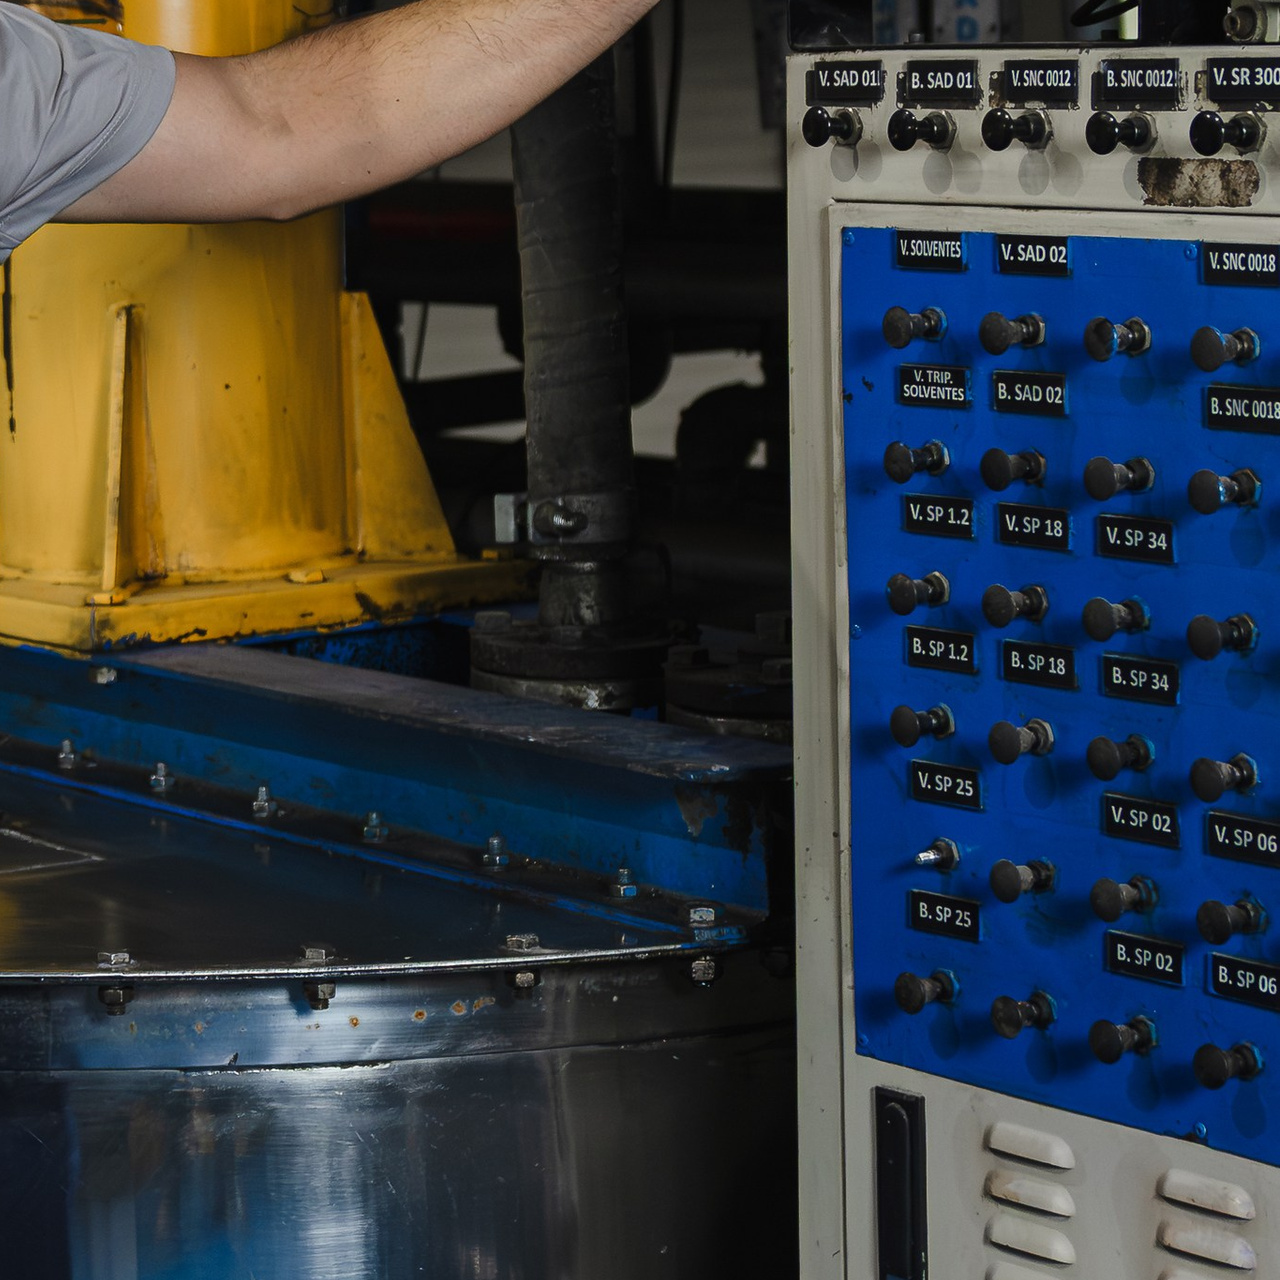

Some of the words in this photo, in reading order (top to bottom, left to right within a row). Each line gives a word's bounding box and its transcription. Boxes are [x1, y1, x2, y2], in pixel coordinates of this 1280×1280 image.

[819, 69, 830, 87] V.
[833, 69, 858, 87] SAD
[911, 72, 924, 88] B.
[927, 71, 954, 89] SAD
[956, 72, 973, 88] 01
[1011, 69, 1021, 87] V.
[1023, 69, 1044, 87] SNC
[1045, 69, 1071, 87] 0012
[1106, 69, 1119, 88] B.
[1120, 69, 1144, 88] SNC
[1213, 67, 1227, 85] V.
[1231, 67, 1250, 86] SR
[900, 239, 909, 256] V.
[910, 239, 961, 258] SOLVENTES
[1001, 243, 1014, 261] V.
[1017, 244, 1046, 263] SAD
[1049, 245, 1067, 264] 02
[1209, 251, 1221, 270] V.
[1222, 252, 1246, 271] SNC
[1248, 253, 1276, 273] 0018
[913, 369, 924, 382] V.
[926, 370, 953, 385] TRIP.
[903, 384, 965, 401] SOLVENTES
[998, 382, 1011, 400] B.
[1014, 385, 1043, 401] SAD
[1045, 386, 1063, 404] 02
[1210, 397, 1223, 416] B.
[1225, 398, 1249, 418] SNC
[1251, 400, 1280, 420] 0018
[909, 503, 923, 520] V.
[926, 505, 944, 522] SP
[947, 508, 970, 526] 1.2
[1005, 514, 1019, 532] V.
[1022, 516, 1040, 535] SP
[1044, 519, 1063, 537] 18
[1106, 526, 1120, 545] V.
[1124, 529, 1143, 547] SP
[1147, 532, 1168, 551] 34
[913, 637, 926, 655] B.
[928, 640, 945, 658] SP
[948, 643, 969, 661] 1.2
[1011, 651, 1024, 670] B.
[1028, 654, 1045, 672] SP
[1048, 657, 1066, 675] 18
[1112, 667, 1126, 685] B.
[1130, 669, 1148, 688] SP
[1151, 672, 1169, 692] 34
[918, 771, 931, 790] V.
[935, 775, 953, 792] SP
[956, 778, 974, 797] 25
[1111, 805, 1126, 824] V.
[1129, 809, 1148, 828] SP
[1152, 813, 1171, 833] 02
[1214, 824, 1229, 845] V.
[1233, 829, 1253, 848] SP
[1257, 833, 1278, 853] 06
[919, 902, 932, 919] B.
[935, 905, 952, 923] SP
[955, 909, 971, 928] 25
[1116, 943, 1131, 963] B.
[1134, 948, 1152, 967] SP
[1155, 952, 1173, 972] 02
[1218, 965, 1232, 985] B.
[1237, 970, 1255, 989] SP
[1258, 975, 1277, 995] 06
